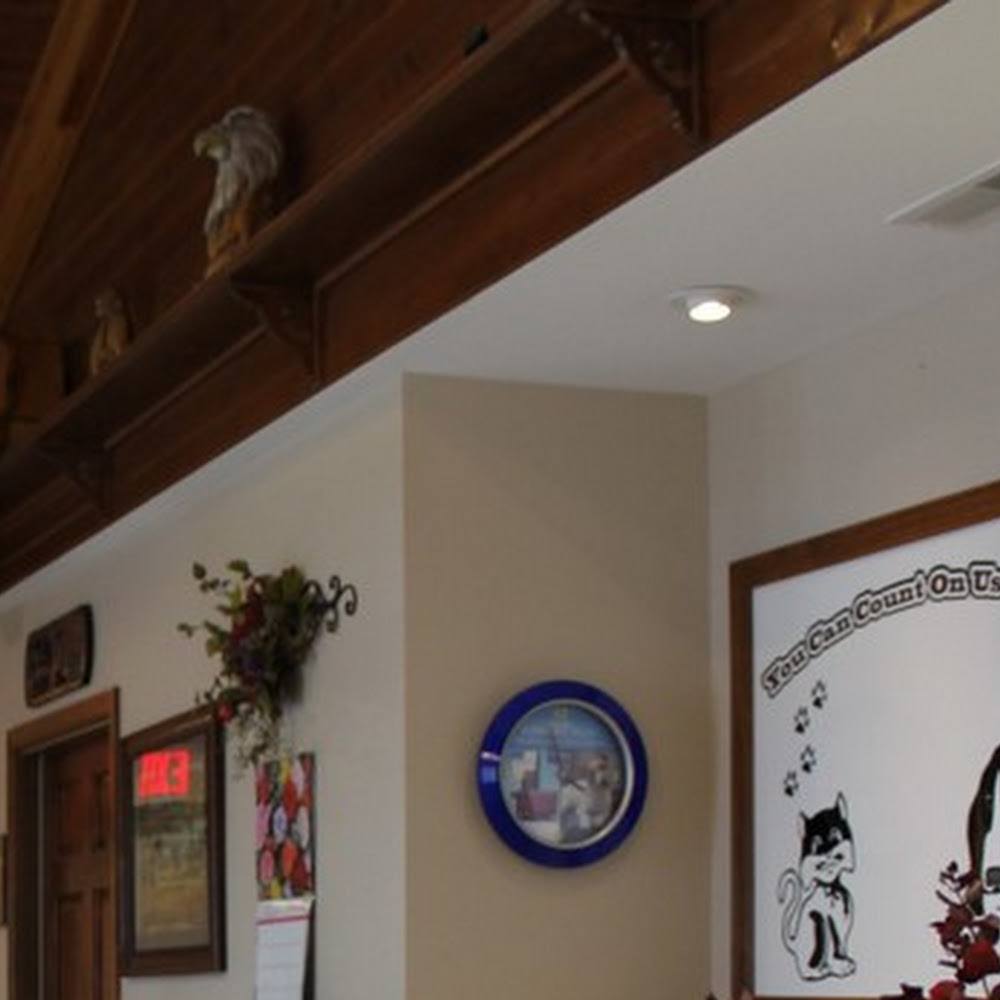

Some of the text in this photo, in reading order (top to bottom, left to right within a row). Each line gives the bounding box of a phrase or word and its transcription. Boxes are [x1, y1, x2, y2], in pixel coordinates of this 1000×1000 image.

[763, 646, 806, 695] You
[807, 610, 852, 654] Can
[854, 574, 925, 623] Count
[929, 570, 967, 596] On
